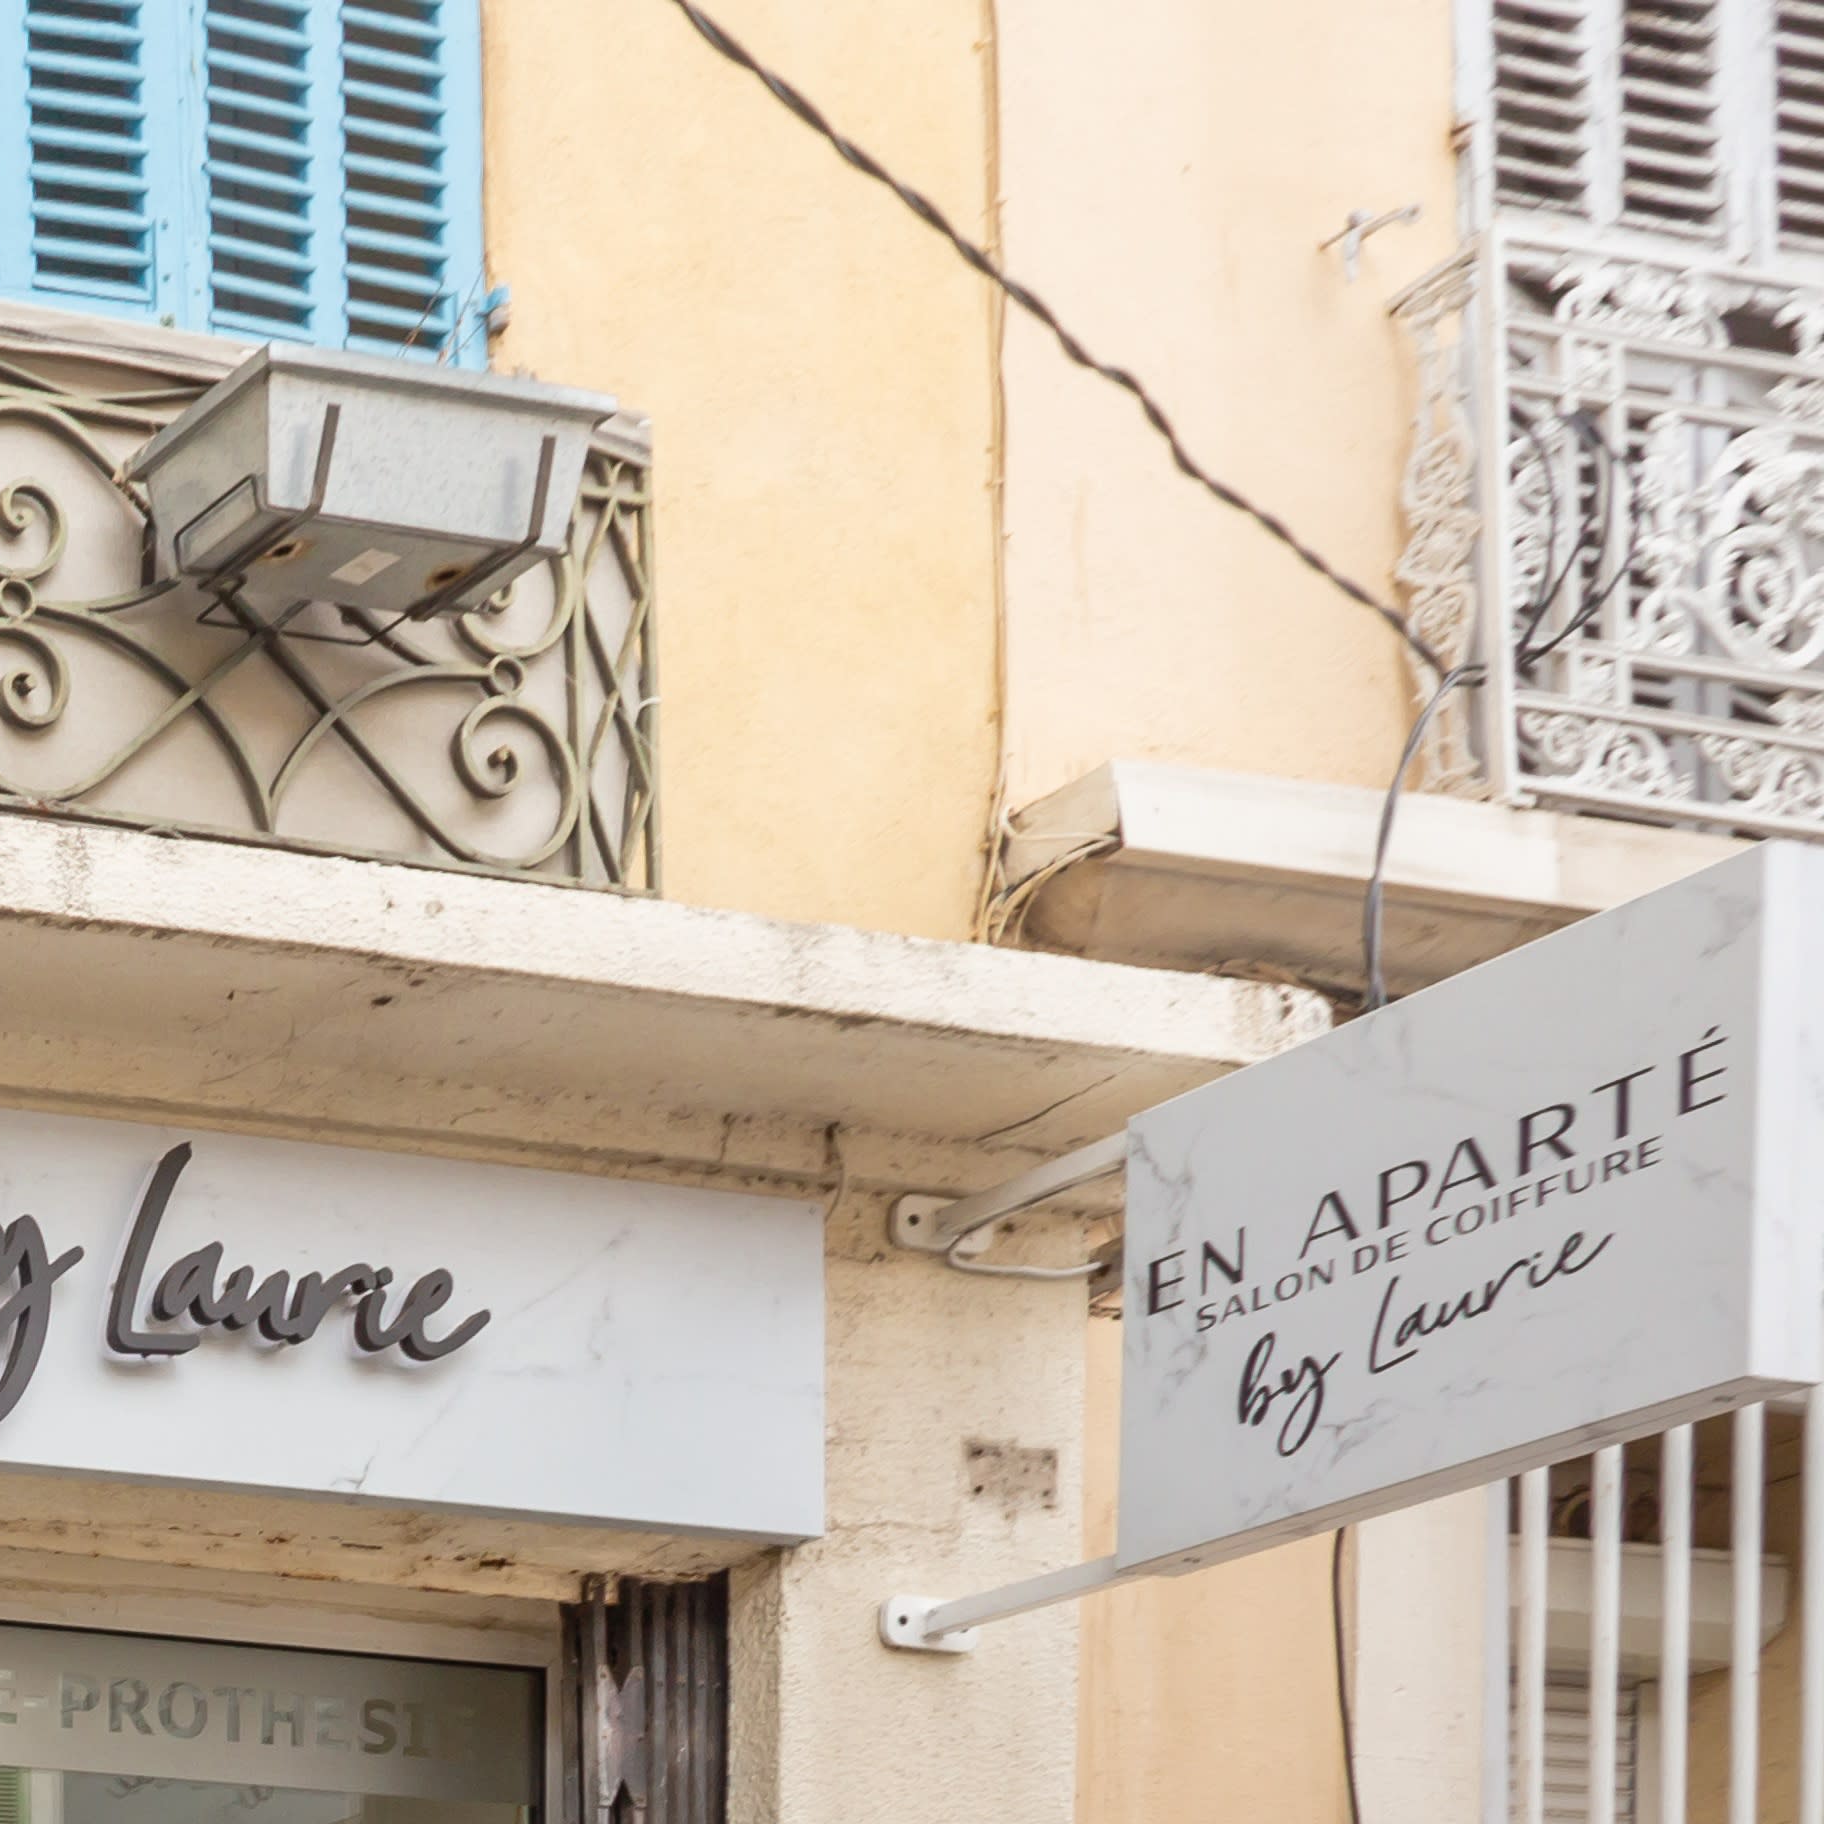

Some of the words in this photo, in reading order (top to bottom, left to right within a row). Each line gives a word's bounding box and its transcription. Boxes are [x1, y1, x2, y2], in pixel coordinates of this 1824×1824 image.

[105, 1140, 492, 1361] Laurie
[1146, 1227, 1247, 1316] EN
[1299, 1026, 1728, 1260] APARTÉ
[1196, 1258, 1335, 1332] SALON
[1352, 1231, 1409, 1276] DE
[1425, 1134, 1664, 1248] COIFFURE
[1239, 1331, 1343, 1457] by
[1368, 1230, 1616, 1374] Laurie
